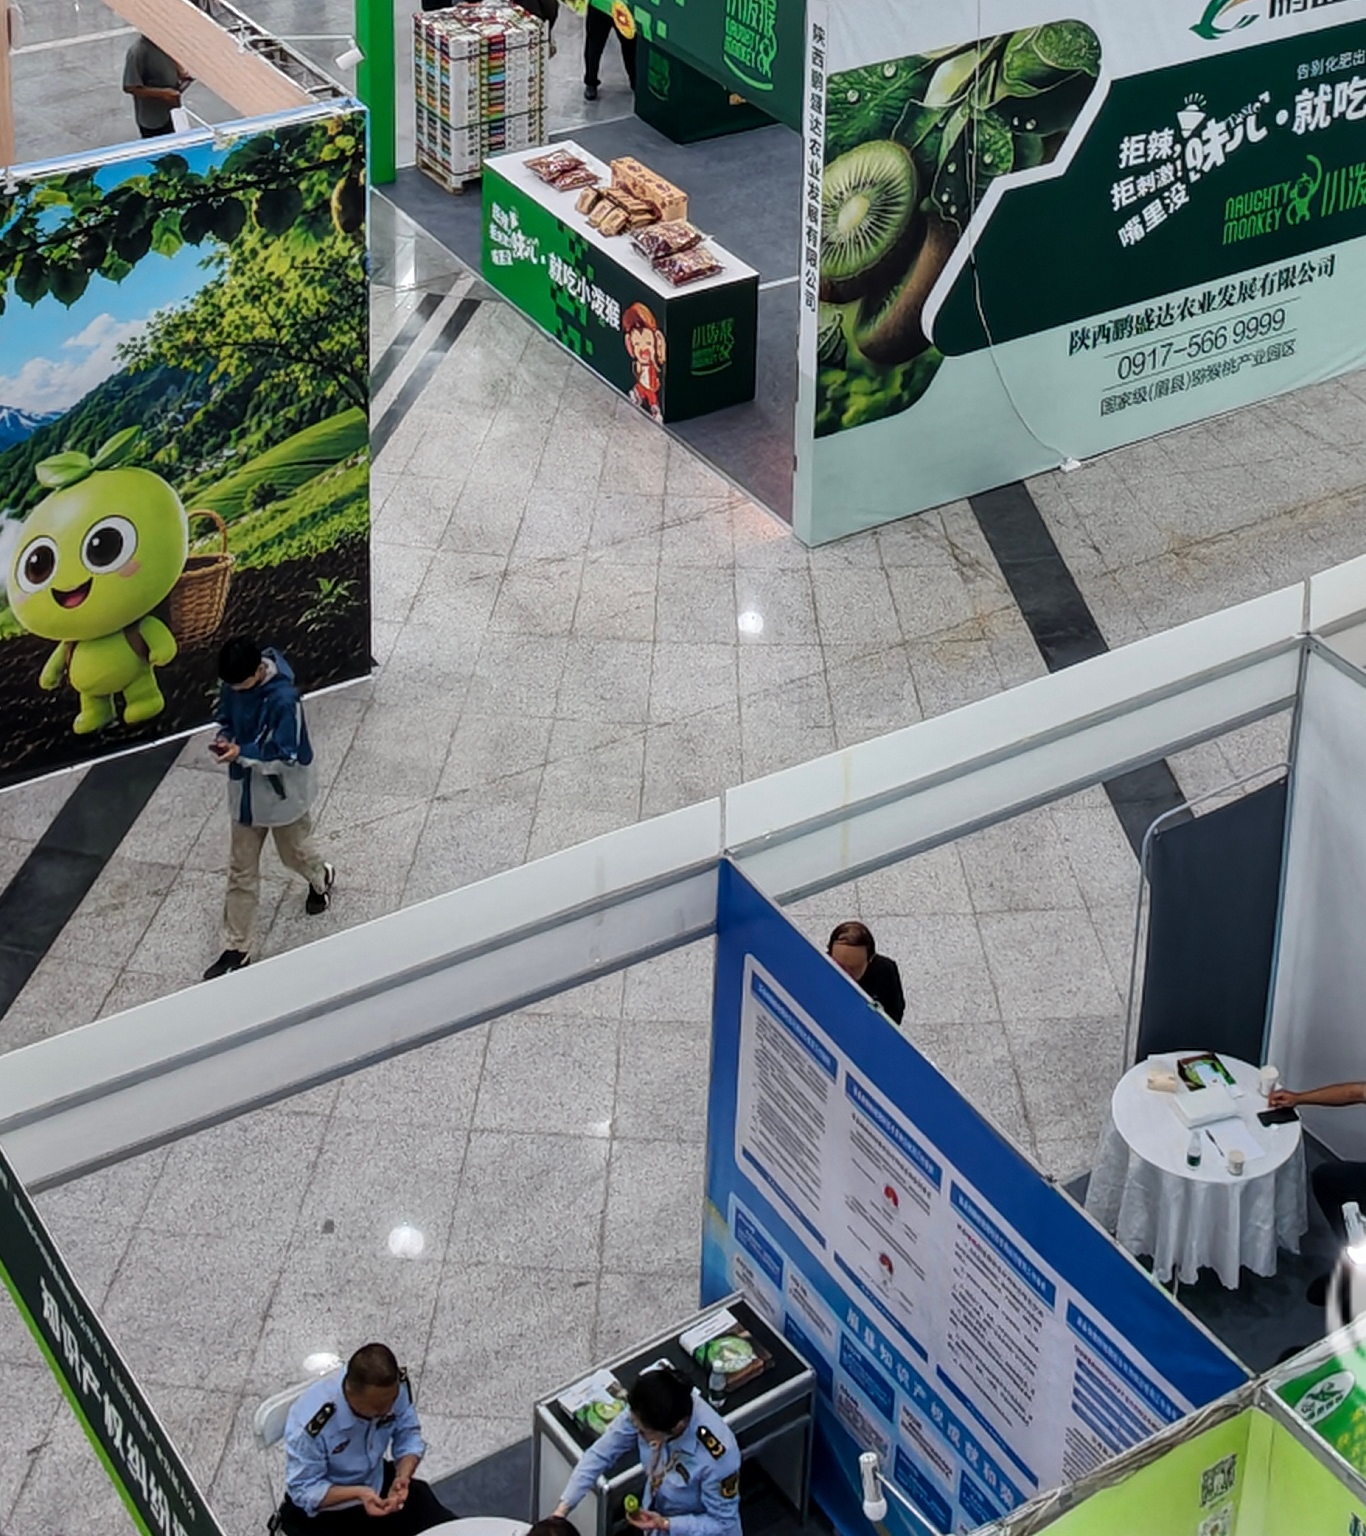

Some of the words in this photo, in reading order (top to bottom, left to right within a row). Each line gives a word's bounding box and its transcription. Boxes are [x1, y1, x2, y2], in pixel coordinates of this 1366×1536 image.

[1118, 126, 1183, 169] 拒辣,
[1110, 159, 1183, 211] 拒刺激!
[1225, 180, 1291, 221] NAUGHTY
[1118, 181, 1190, 248] 嘴里没
[1223, 207, 1282, 246] MONKEY
[1068, 253, 1336, 356] 陕西鹏盛达农业发展有限公司
[1117, 326, 1228, 381] 0917-566
[1233, 308, 1287, 346] 9999
